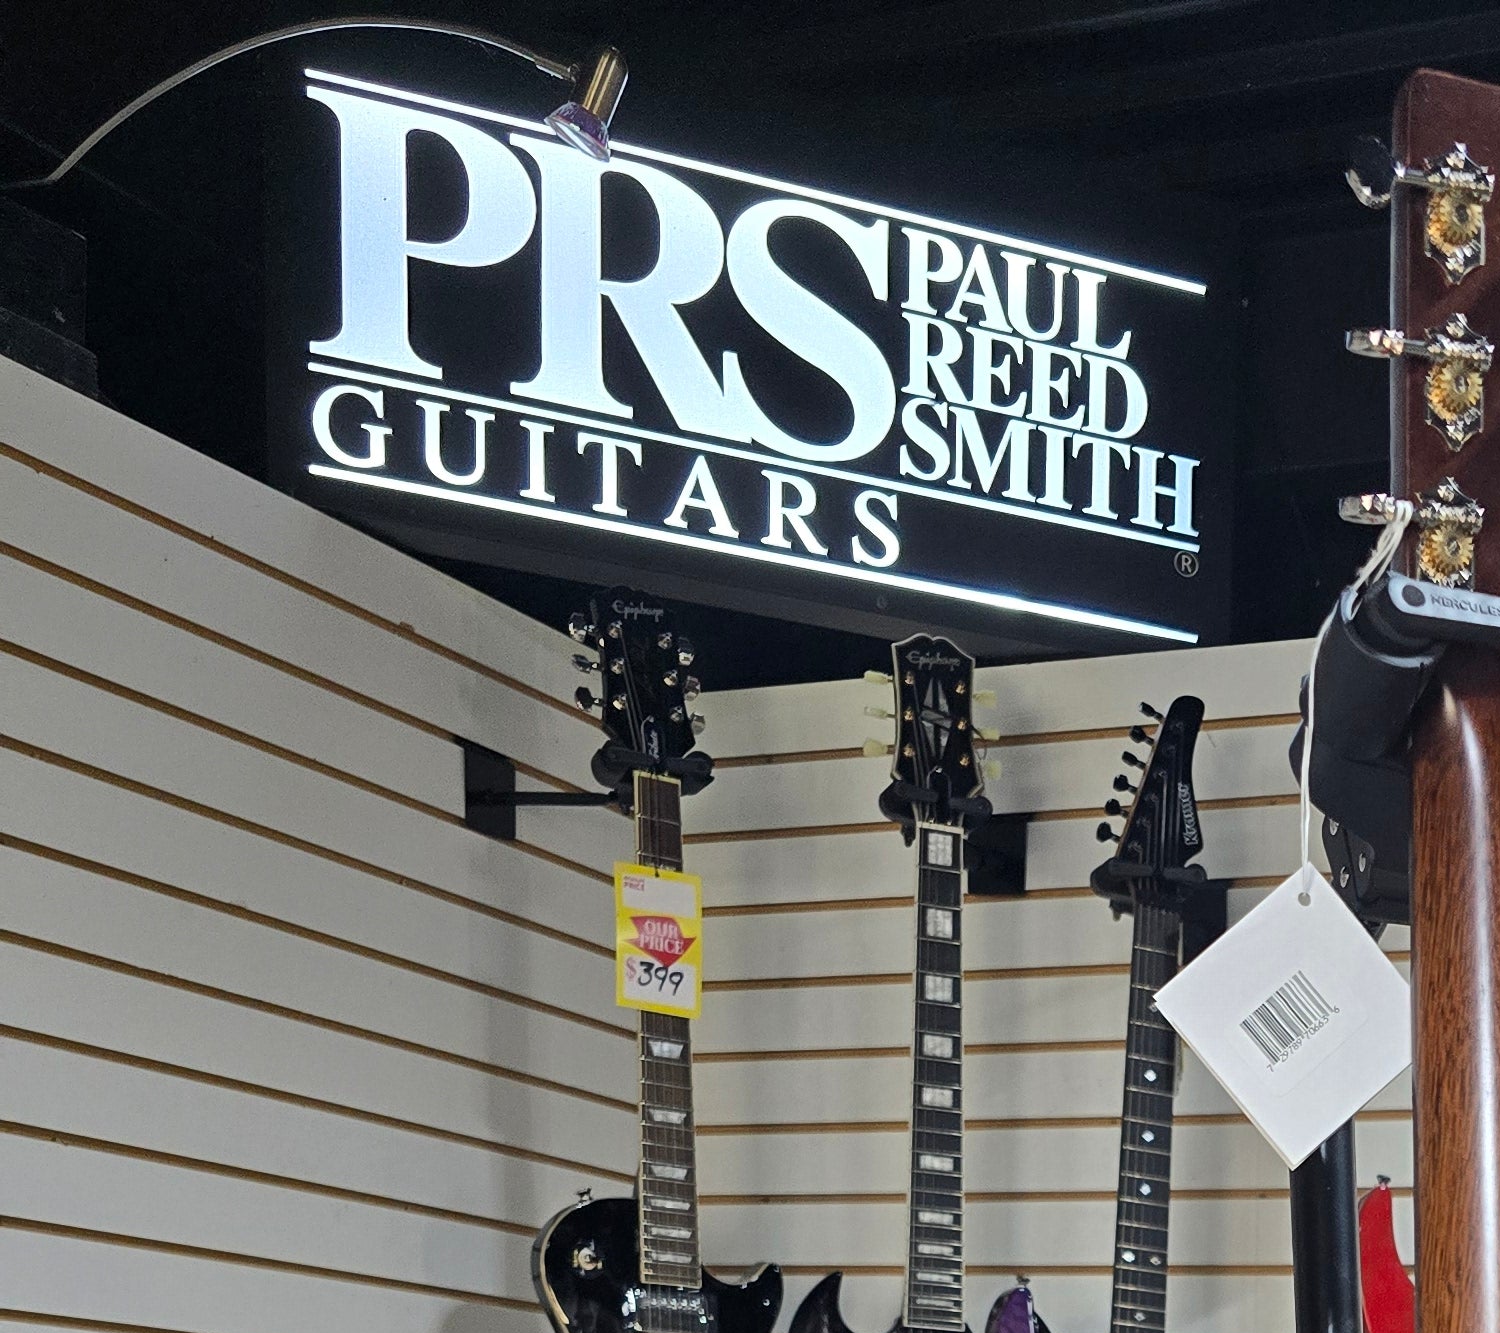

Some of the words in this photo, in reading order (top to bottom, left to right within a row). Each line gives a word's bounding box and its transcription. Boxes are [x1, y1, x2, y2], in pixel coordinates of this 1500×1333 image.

[306, 85, 896, 463] PRS
[900, 227, 1132, 361] PAUL
[900, 311, 1148, 439] REED
[312, 385, 900, 568] GUITARS
[900, 397, 1200, 537] SMITH
[905, 651, 960, 671] Epiphone
[626, 956, 684, 996] $399
[639, 934, 684, 955] PRICE
[644, 919, 678, 938] OUR
